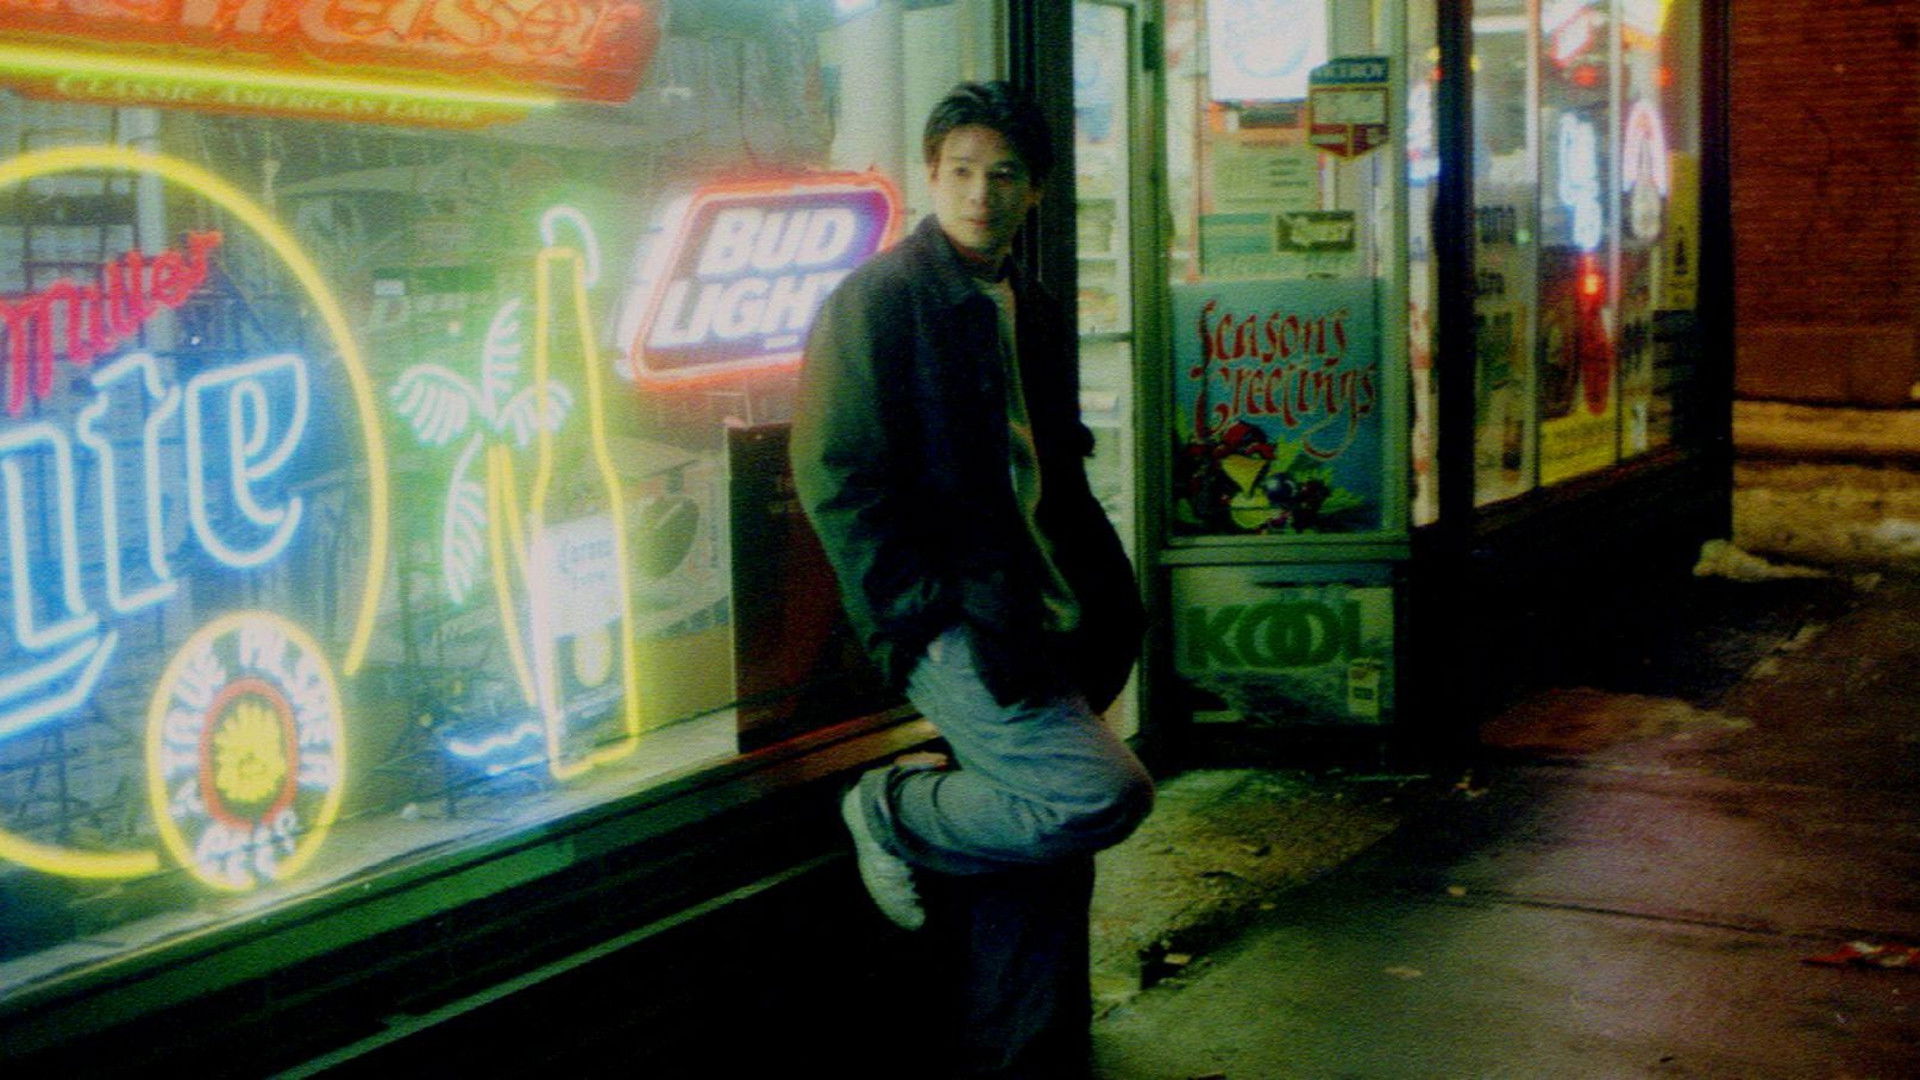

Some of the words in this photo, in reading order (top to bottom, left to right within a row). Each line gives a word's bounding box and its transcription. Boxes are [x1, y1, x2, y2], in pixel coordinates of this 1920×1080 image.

[697, 206, 857, 274] BUD
[0, 229, 223, 418] Miller
[1190, 361, 1377, 461] Greetings
[1186, 599, 1361, 670] KOOL
